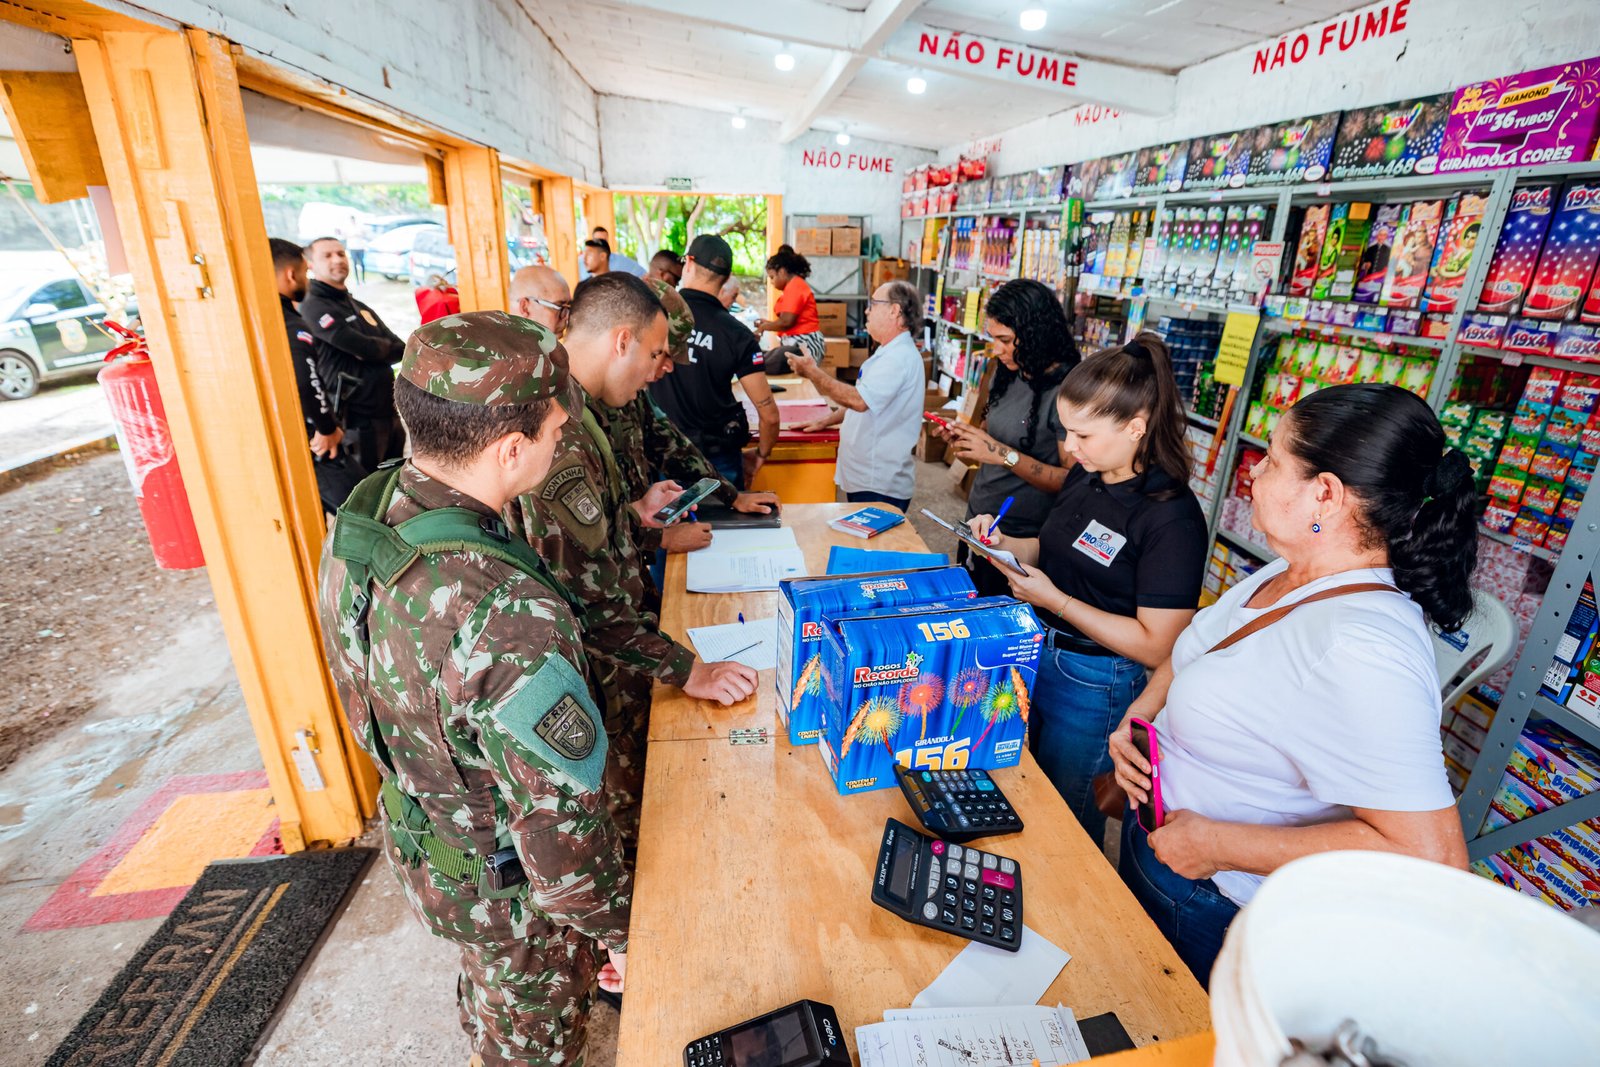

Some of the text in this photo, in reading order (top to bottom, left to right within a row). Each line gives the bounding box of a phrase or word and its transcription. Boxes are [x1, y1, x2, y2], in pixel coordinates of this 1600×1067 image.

[1253, 0, 1411, 75] NÃO FUME
[919, 32, 1078, 86] NÃO FUME
[1503, 87, 1549, 105] DIAMOND
[1476, 110, 1555, 132] KIT 36 TUBOS
[803, 146, 894, 173] NÃO FUME
[1332, 157, 1416, 179] Girândola 468
[1439, 145, 1575, 172] GIRÂNDOLA CORES
[543, 467, 584, 498] MONTANHA
[918, 618, 970, 642] 156
[854, 666, 919, 684] Recorde
[873, 663, 901, 671] FOGOS
[915, 735, 954, 747] GIRÂNDOLA
[895, 737, 971, 769] 156
[947, 877, 957, 886] 9
[945, 893, 956, 901] 8
[984, 888, 994, 896] 3
[963, 882, 976, 924] 4 5 6
[984, 904, 994, 913] 2
[944, 910, 954, 919] 7
[1003, 908, 1014, 920] 00
